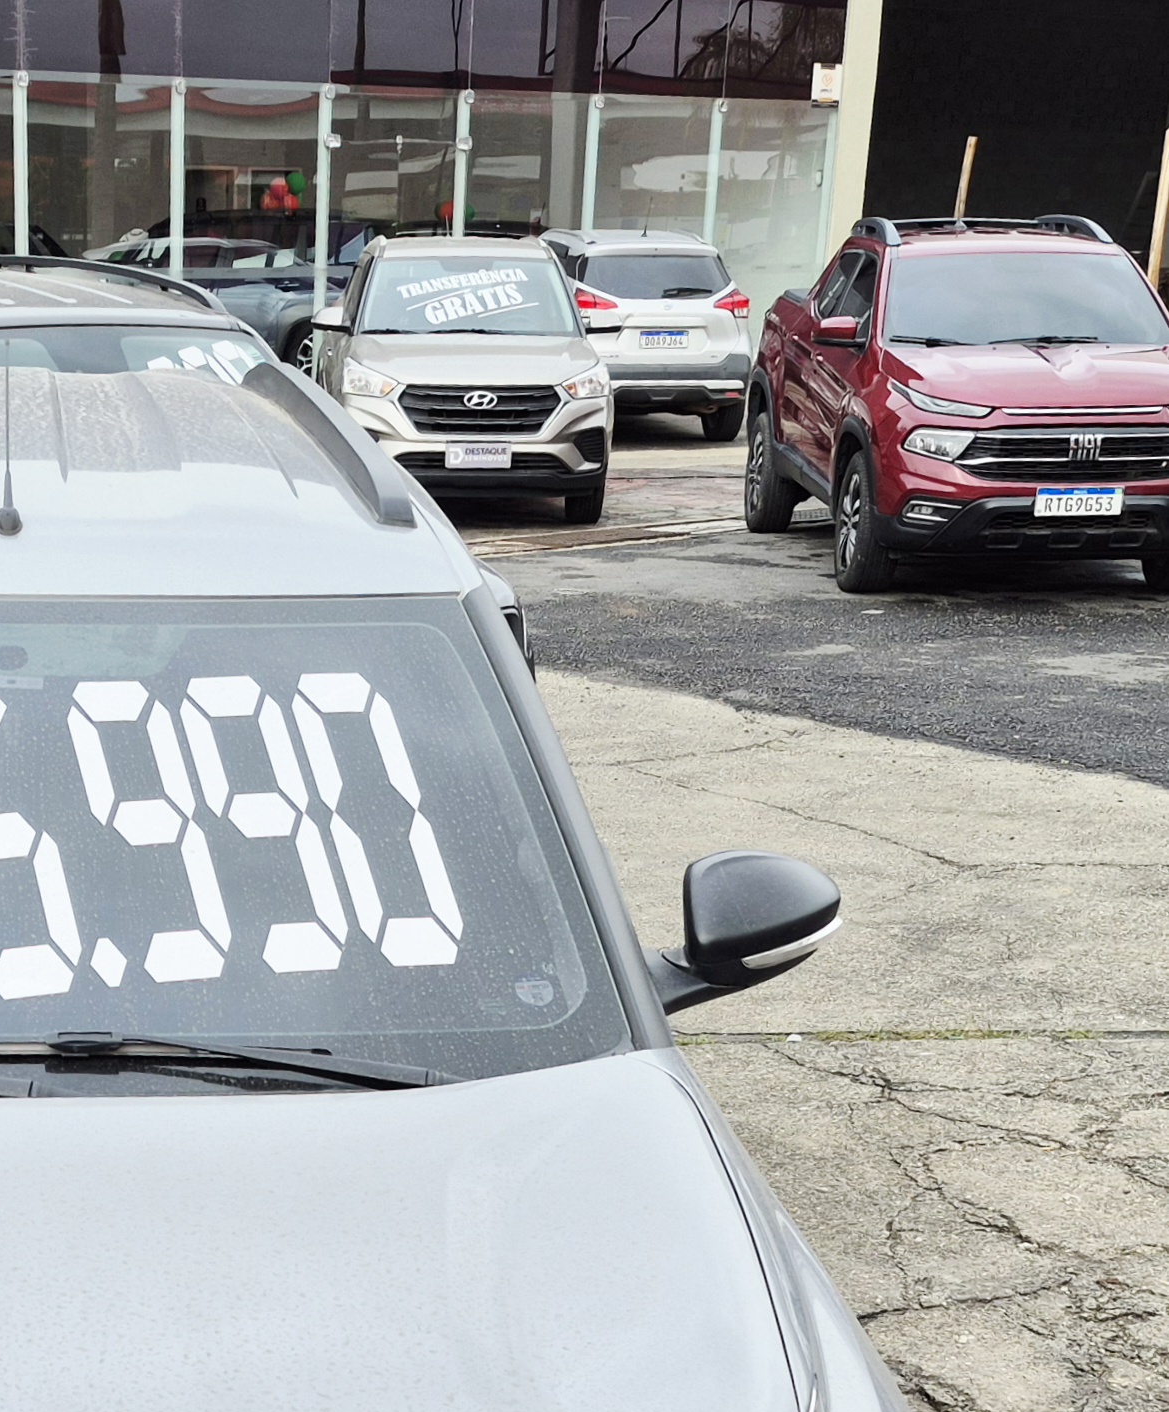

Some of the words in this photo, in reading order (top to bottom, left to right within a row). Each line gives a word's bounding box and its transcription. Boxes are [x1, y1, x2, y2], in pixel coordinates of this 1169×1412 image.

[396, 268, 529, 299] TRANSFERÊNCIA
[424, 283, 523, 325] GRÁTIS
[464, 447, 508, 455] DESTAQUE
[1068, 434, 1102, 460] FIAT
[1044, 496, 1114, 512] RTG9G53
